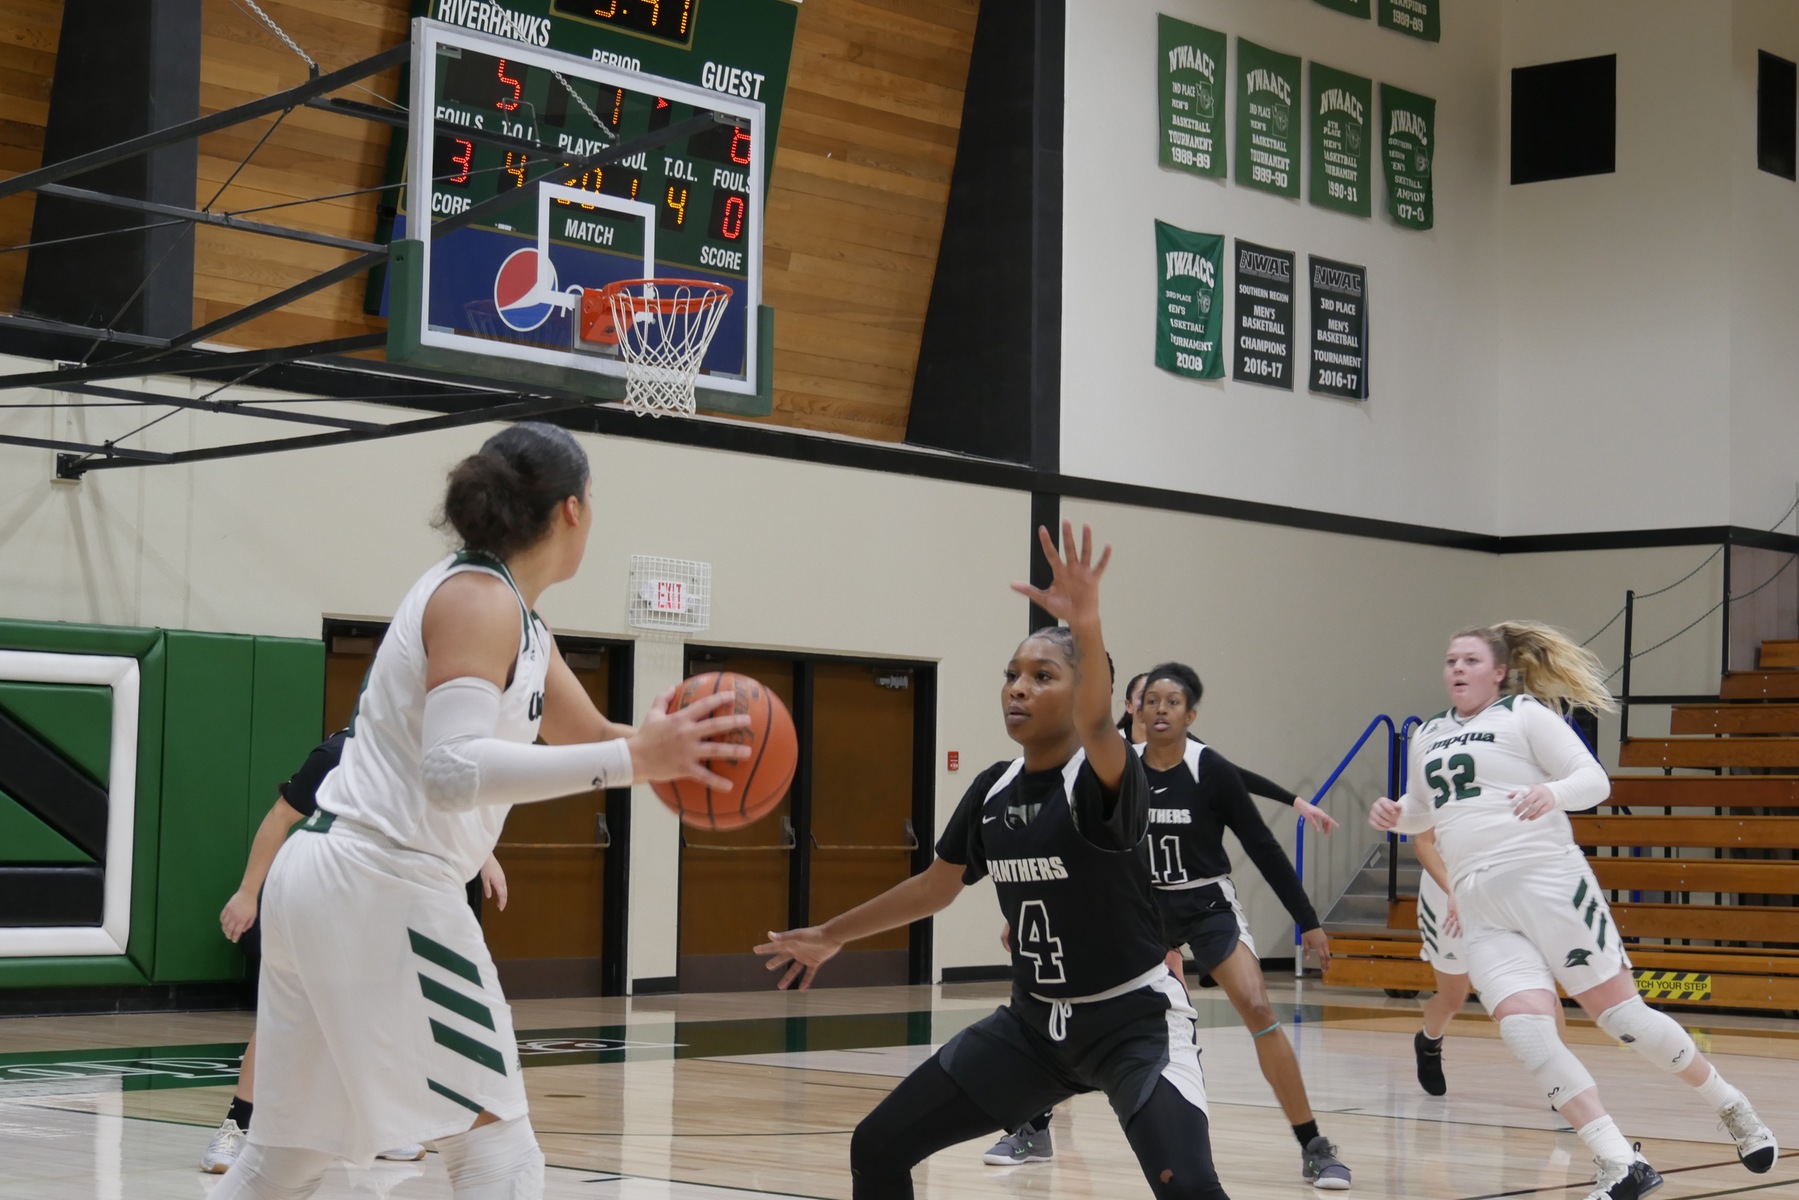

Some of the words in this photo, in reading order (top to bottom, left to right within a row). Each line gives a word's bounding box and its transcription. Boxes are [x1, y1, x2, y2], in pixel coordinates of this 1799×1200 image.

[438, 0, 551, 47] RIVERHAWKS
[592, 49, 641, 73] PERIOD
[1168, 45, 1215, 84] NWAACC
[701, 61, 766, 100] GUEST
[1182, 84, 1195, 97] PLACE
[1246, 69, 1291, 106] NWAACC
[1320, 88, 1363, 125] NWAACC
[1172, 114, 1211, 132] BASKETBALL
[1168, 130, 1213, 151] TOURNAMENT
[1252, 133, 1287, 152] BASKETBALL
[450, 138, 472, 183] 3
[506, 151, 526, 187] 4
[664, 157, 698, 182] T.O.L.
[1250, 148, 1290, 171] TOURNAMENT
[713, 168, 752, 194] FOULS
[1252, 165, 1288, 188] 1989-90
[431, 192, 472, 215] CORE
[667, 186, 688, 225] 4
[723, 196, 745, 239] 0
[564, 218, 615, 246] MATCH
[700, 246, 743, 270] SCORE
[1240, 250, 1290, 278] NWAC
[1165, 251, 1215, 289] NWAACC
[1314, 265, 1361, 292] NWAC
[1177, 294, 1192, 303] PLACE
[1239, 284, 1269, 299] SOUTHERN
[1269, 289, 1289, 303] REGION
[1253, 305, 1276, 320] MEN'S
[1320, 297, 1334, 311] 3RD
[1335, 301, 1356, 315] PLACE
[1170, 318, 1205, 333] SKETBALL
[1242, 316, 1285, 335] BASKETBALL
[1328, 318, 1349, 333] MEN'S
[1240, 336, 1286, 357] CHAMPIONS
[1317, 329, 1359, 348] BASKETBALL
[1243, 357, 1283, 379] 2016-17
[1313, 350, 1362, 368] TOURNAMENT
[1318, 369, 1358, 390] 2016-17
[657, 581, 682, 610] EXIT
[1425, 753, 1482, 809] 52
[1148, 807, 1192, 824] THERS
[1018, 899, 1067, 984] 4
[1636, 980, 1654, 989] TCH
[1655, 981, 1682, 990] YOUR
[1683, 982, 1708, 991] STEP
